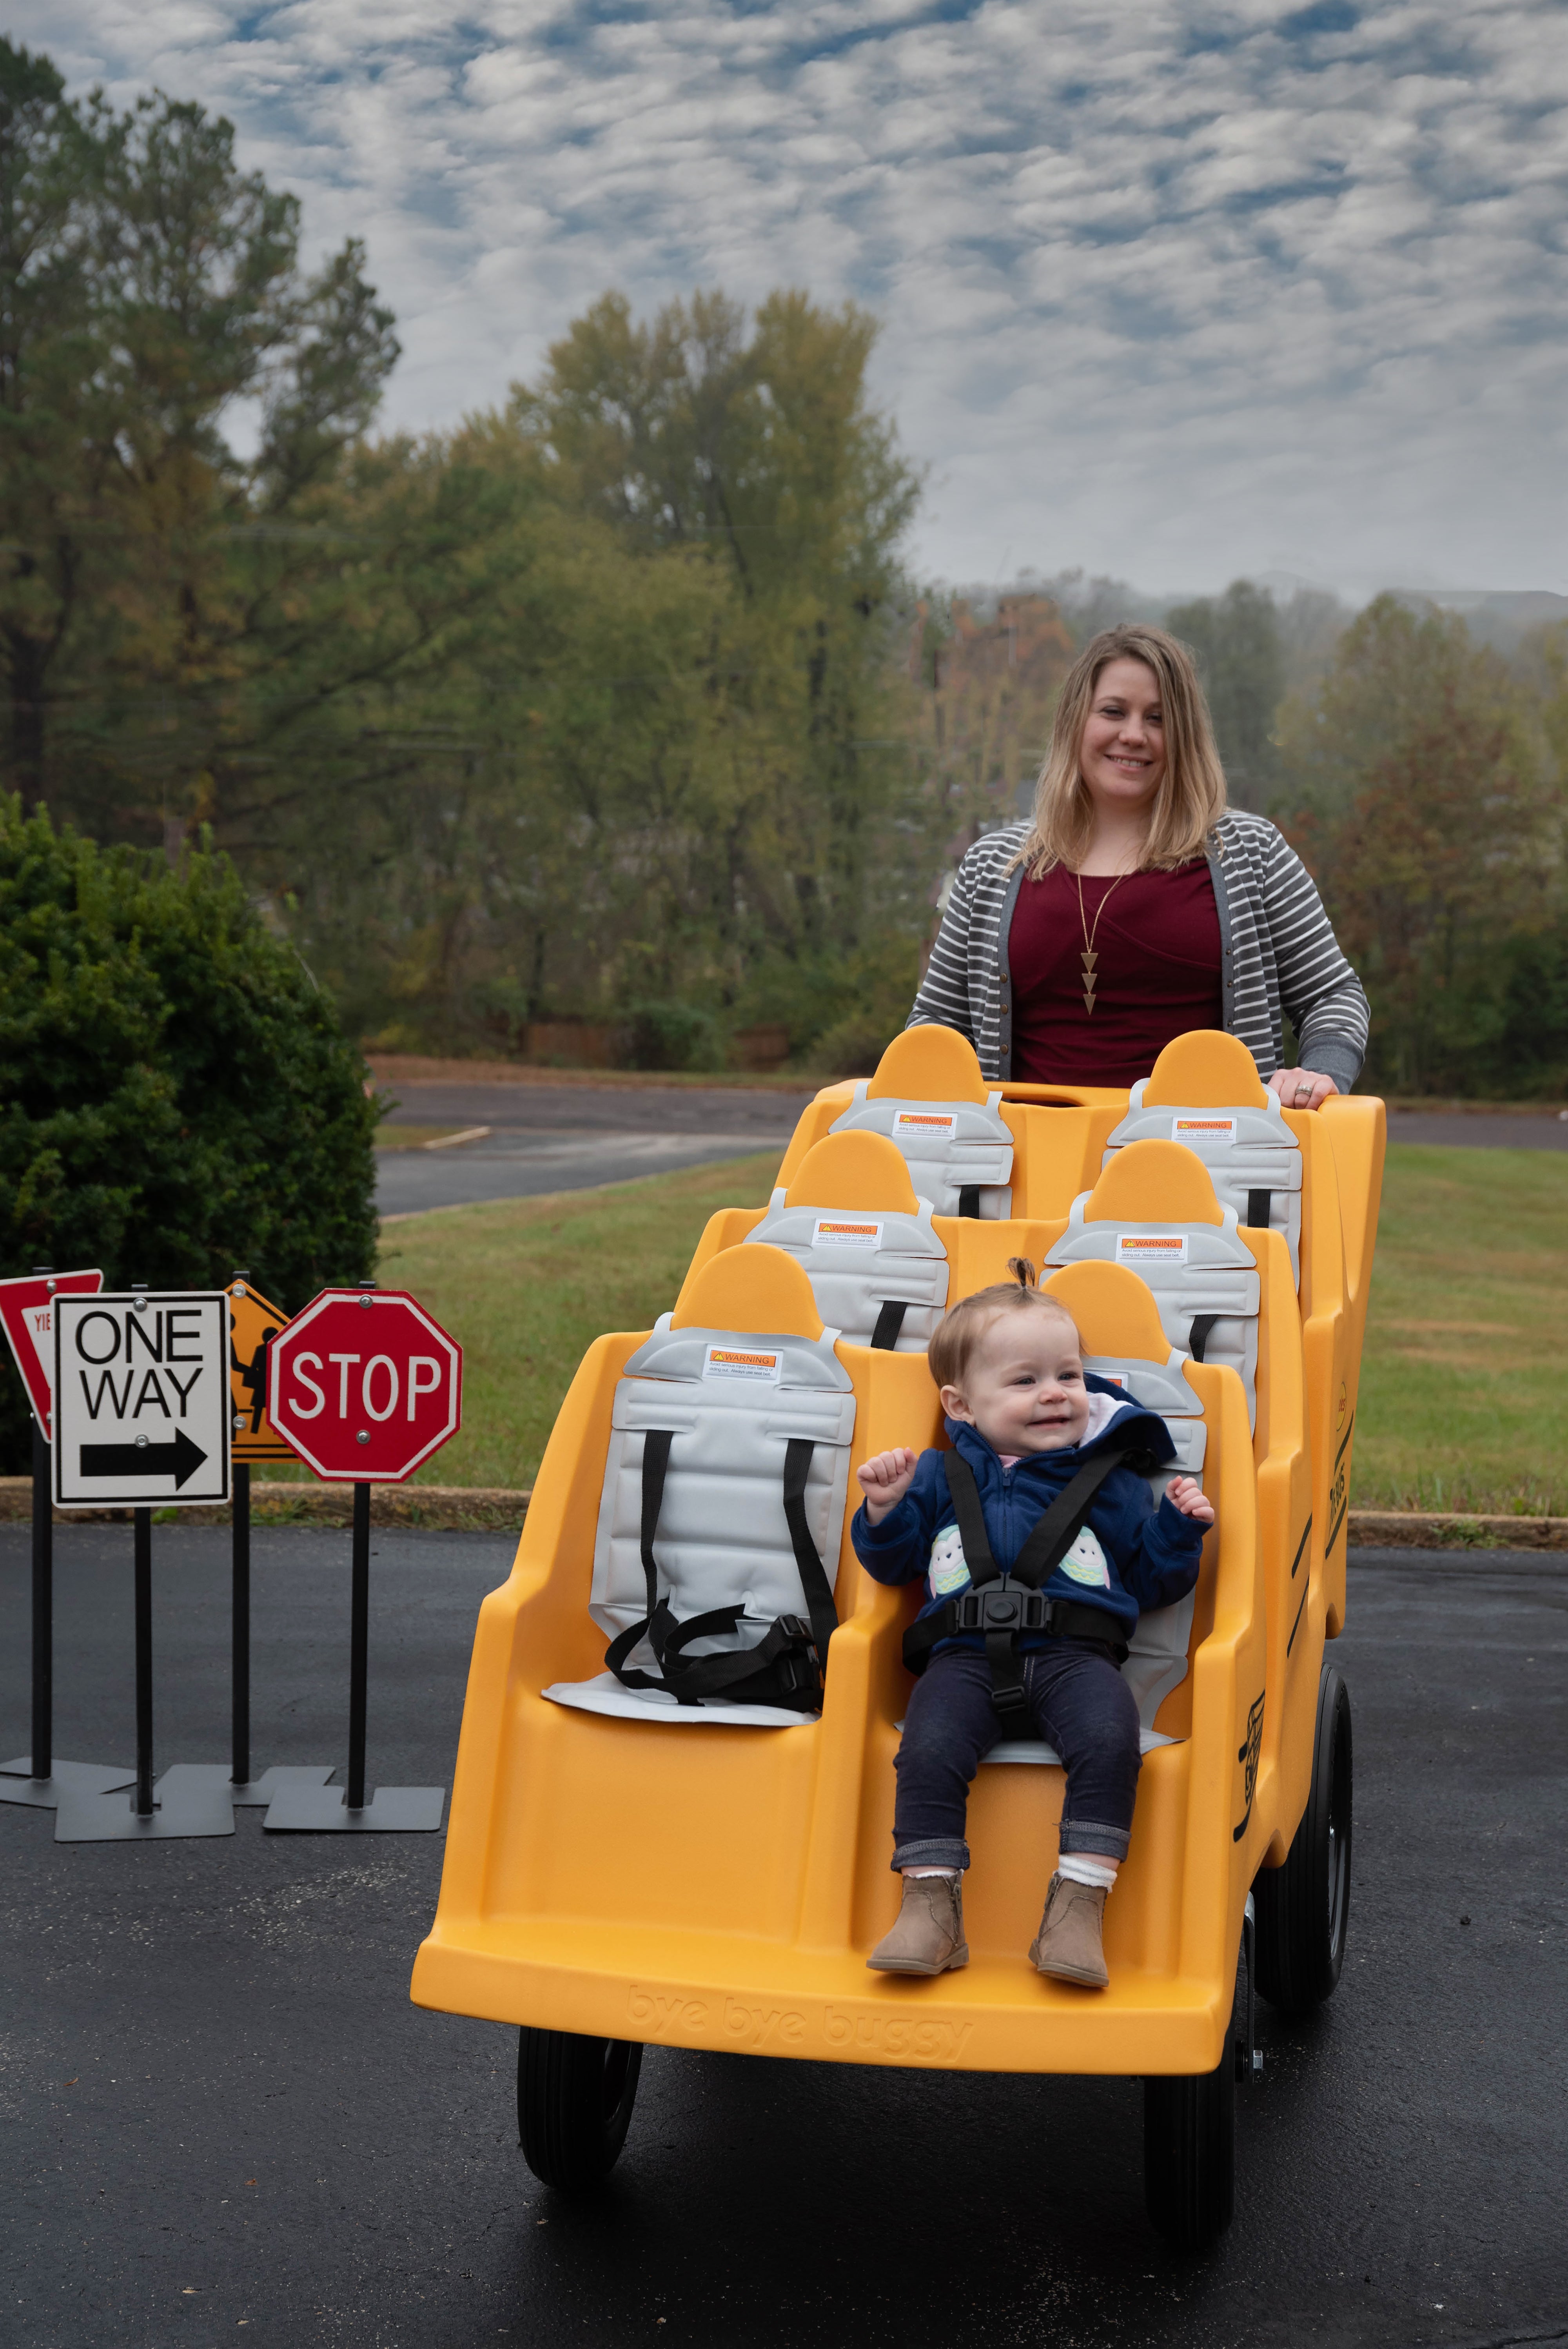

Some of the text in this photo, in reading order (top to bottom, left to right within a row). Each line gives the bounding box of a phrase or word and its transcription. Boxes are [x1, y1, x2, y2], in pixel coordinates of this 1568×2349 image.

[75, 1309, 203, 1364] ONE
[725, 1354, 769, 1364] WARNING
[79, 1367, 203, 1420] WAY
[288, 1351, 442, 1422] STOP
[627, 1984, 974, 2063] bye bye buggy
